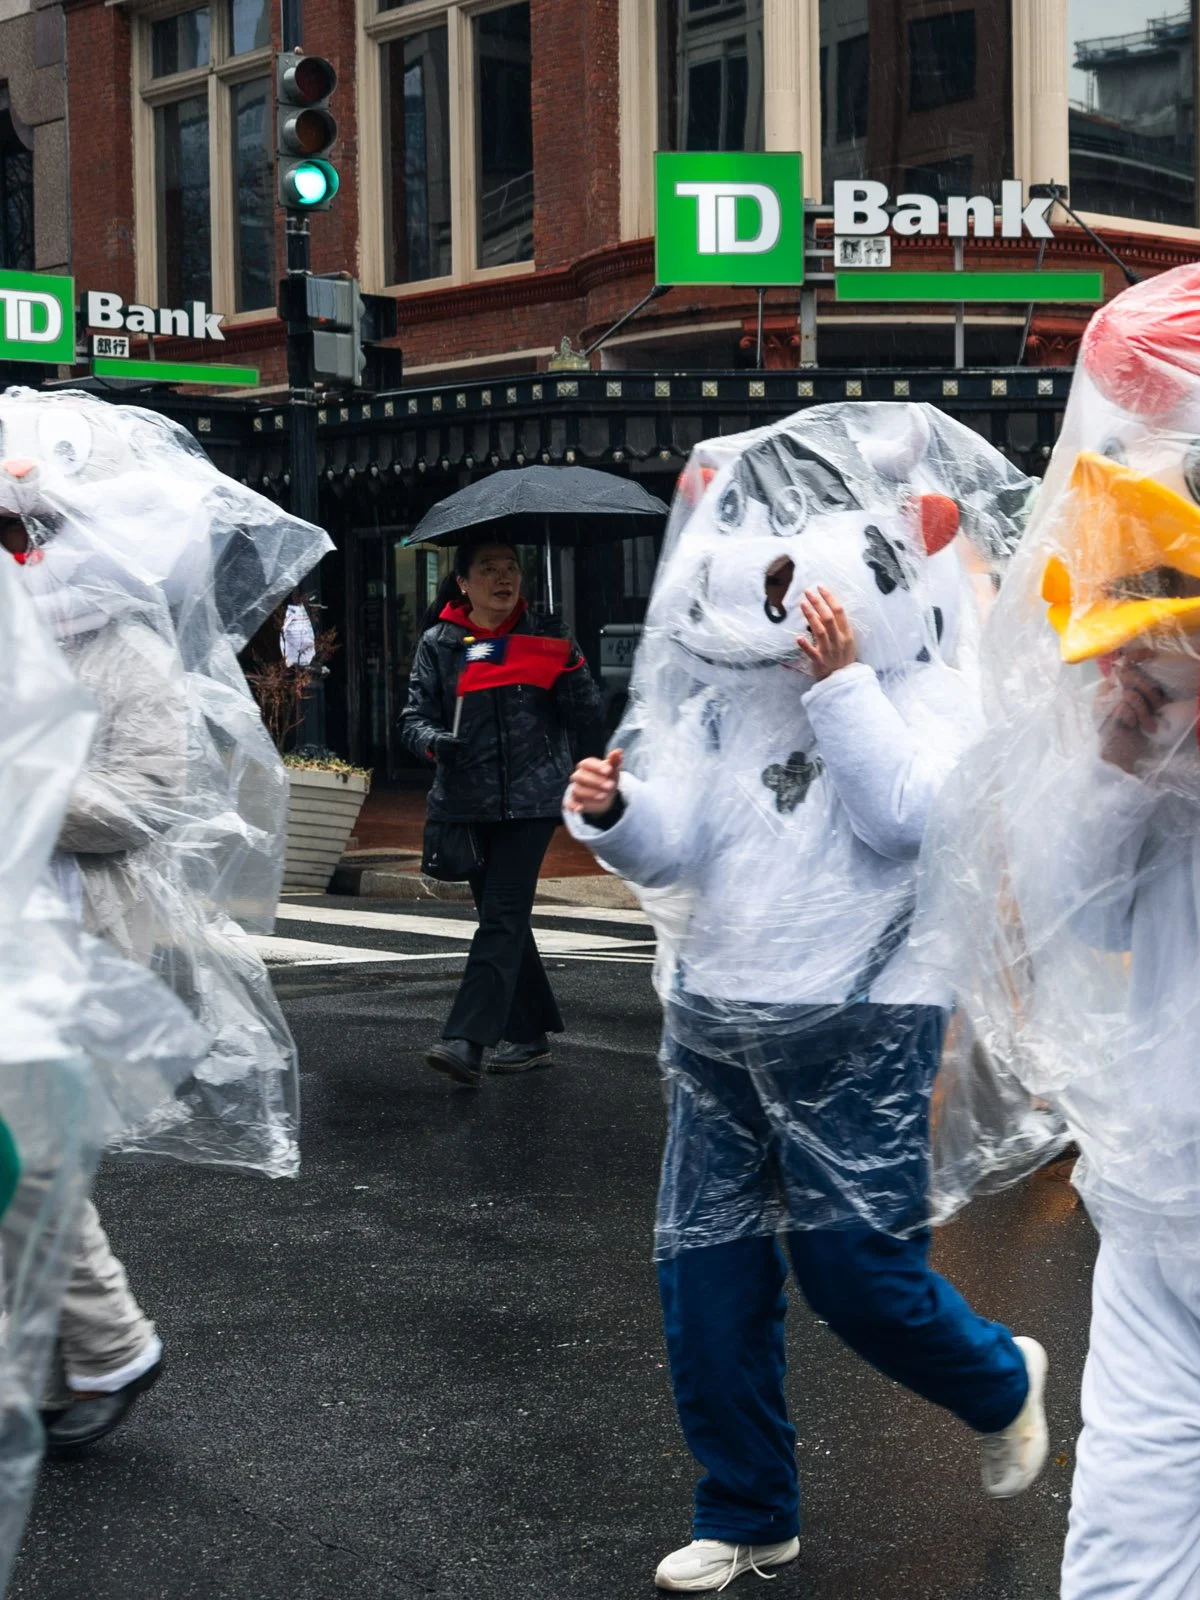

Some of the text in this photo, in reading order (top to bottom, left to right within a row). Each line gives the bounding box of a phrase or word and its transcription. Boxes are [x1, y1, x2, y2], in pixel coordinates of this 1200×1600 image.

[675, 180, 1055, 254] TD Bank
[88, 290, 226, 341] Bank
[97, 337, 127, 355] 銀行
